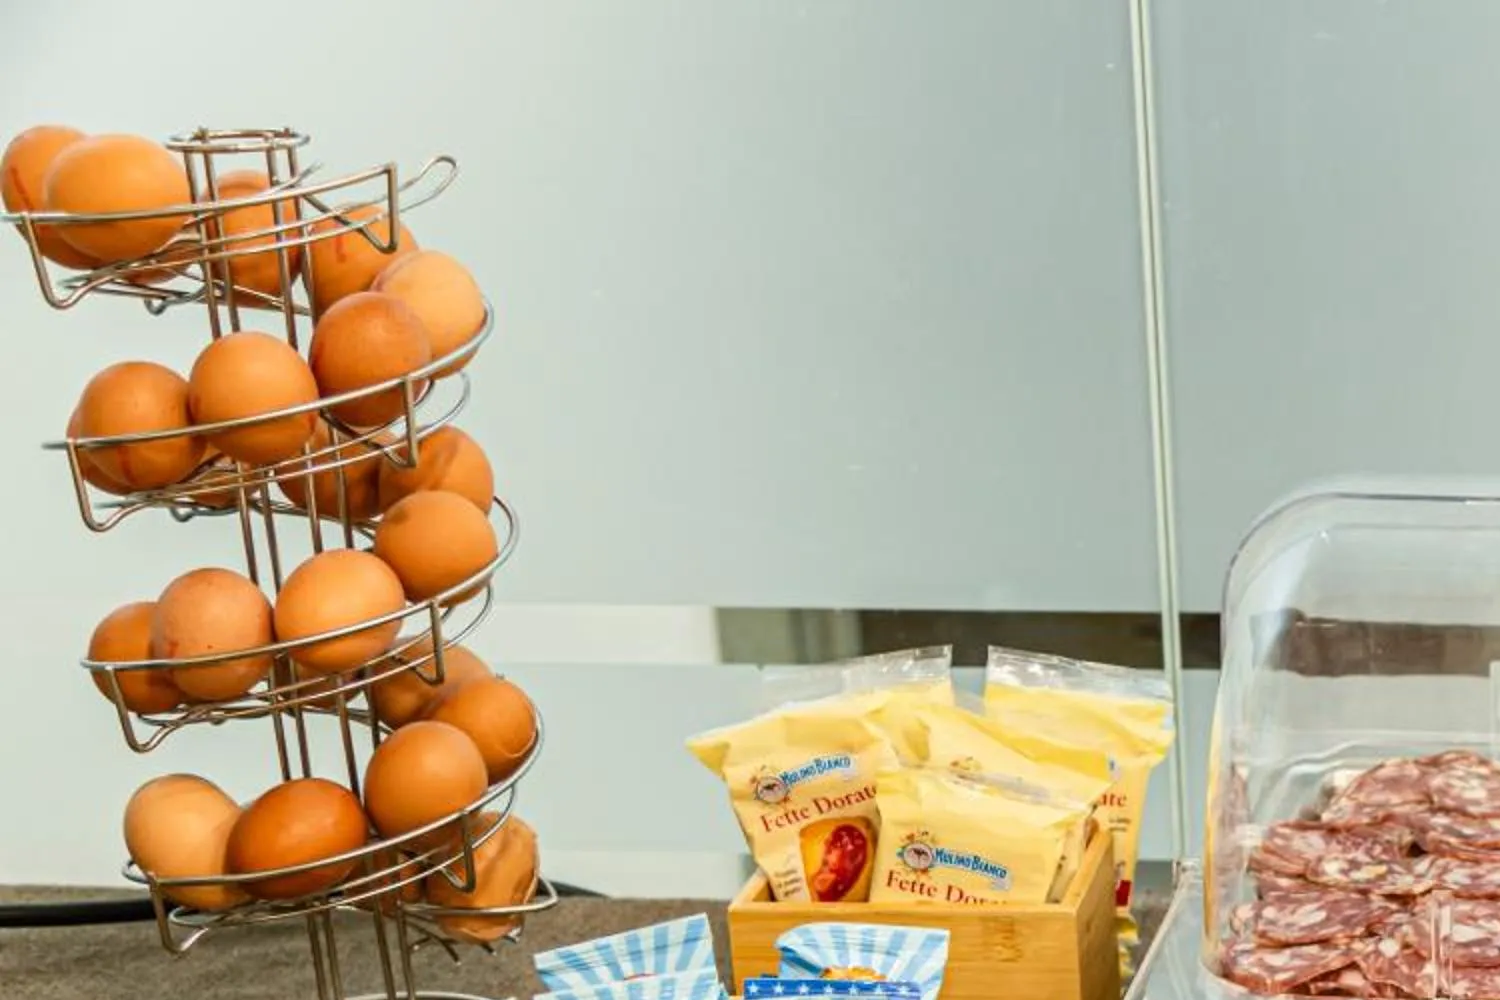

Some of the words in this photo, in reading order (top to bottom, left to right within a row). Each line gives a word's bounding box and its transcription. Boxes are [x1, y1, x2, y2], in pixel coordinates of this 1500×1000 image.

[760, 806, 810, 832] Fette
[971, 856, 1008, 879] BIANCO
[886, 868, 938, 897] Fette
